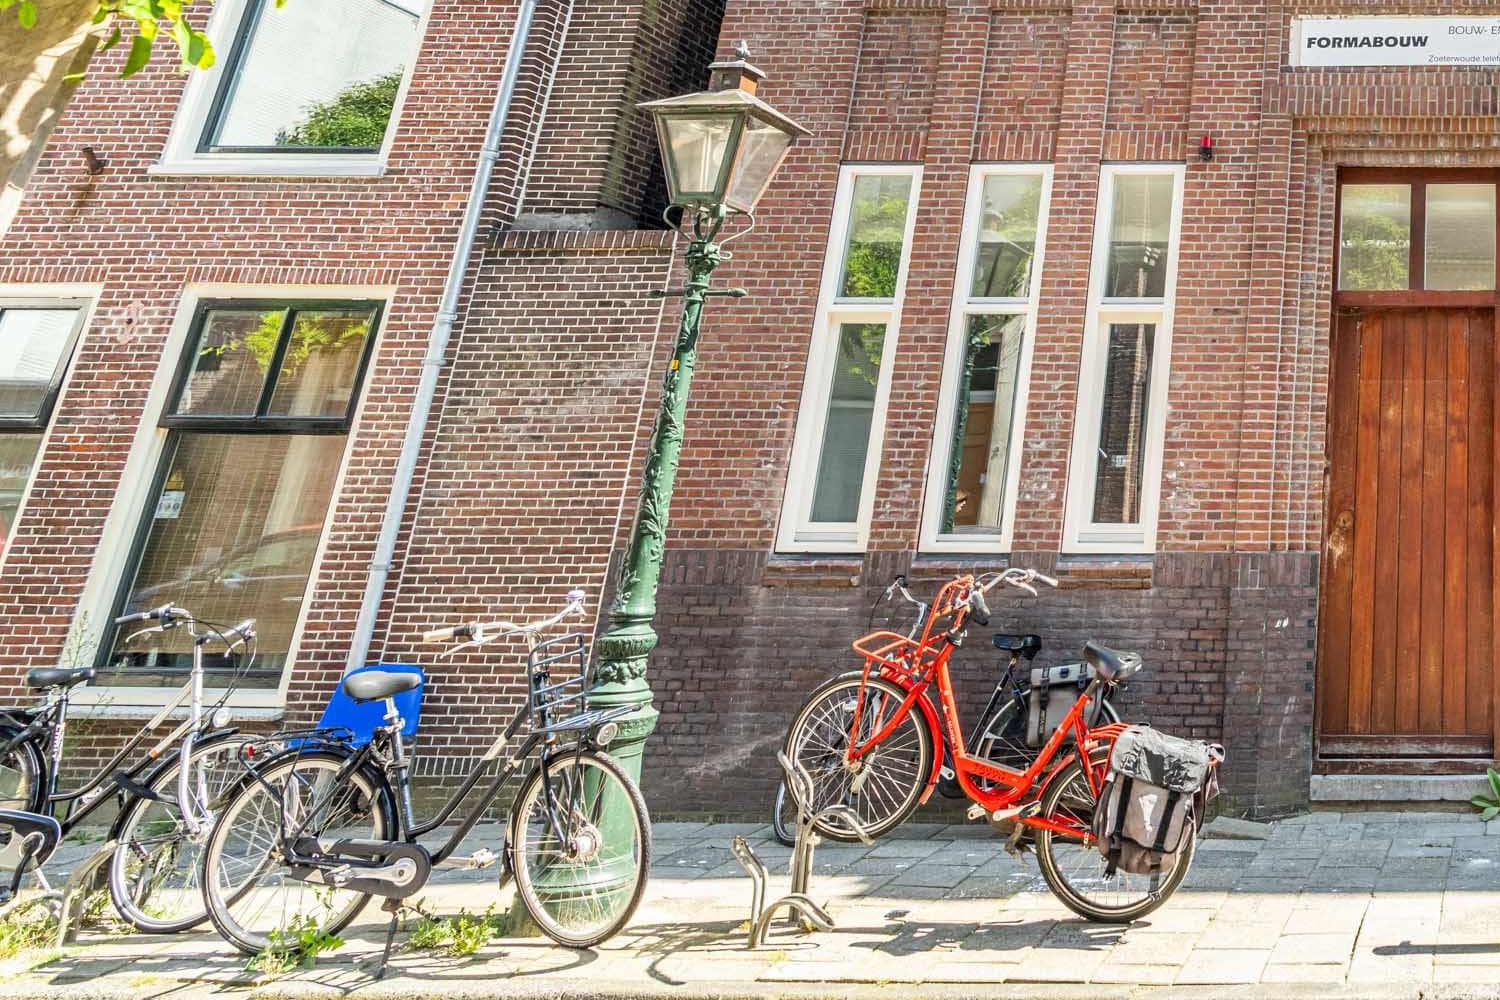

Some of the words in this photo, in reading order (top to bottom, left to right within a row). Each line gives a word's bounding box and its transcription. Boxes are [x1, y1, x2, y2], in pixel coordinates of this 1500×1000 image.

[1448, 25, 1488, 35] BOUW-
[1306, 35, 1429, 49] FORMABOUW
[1428, 54, 1481, 63] Zoeterwoude
